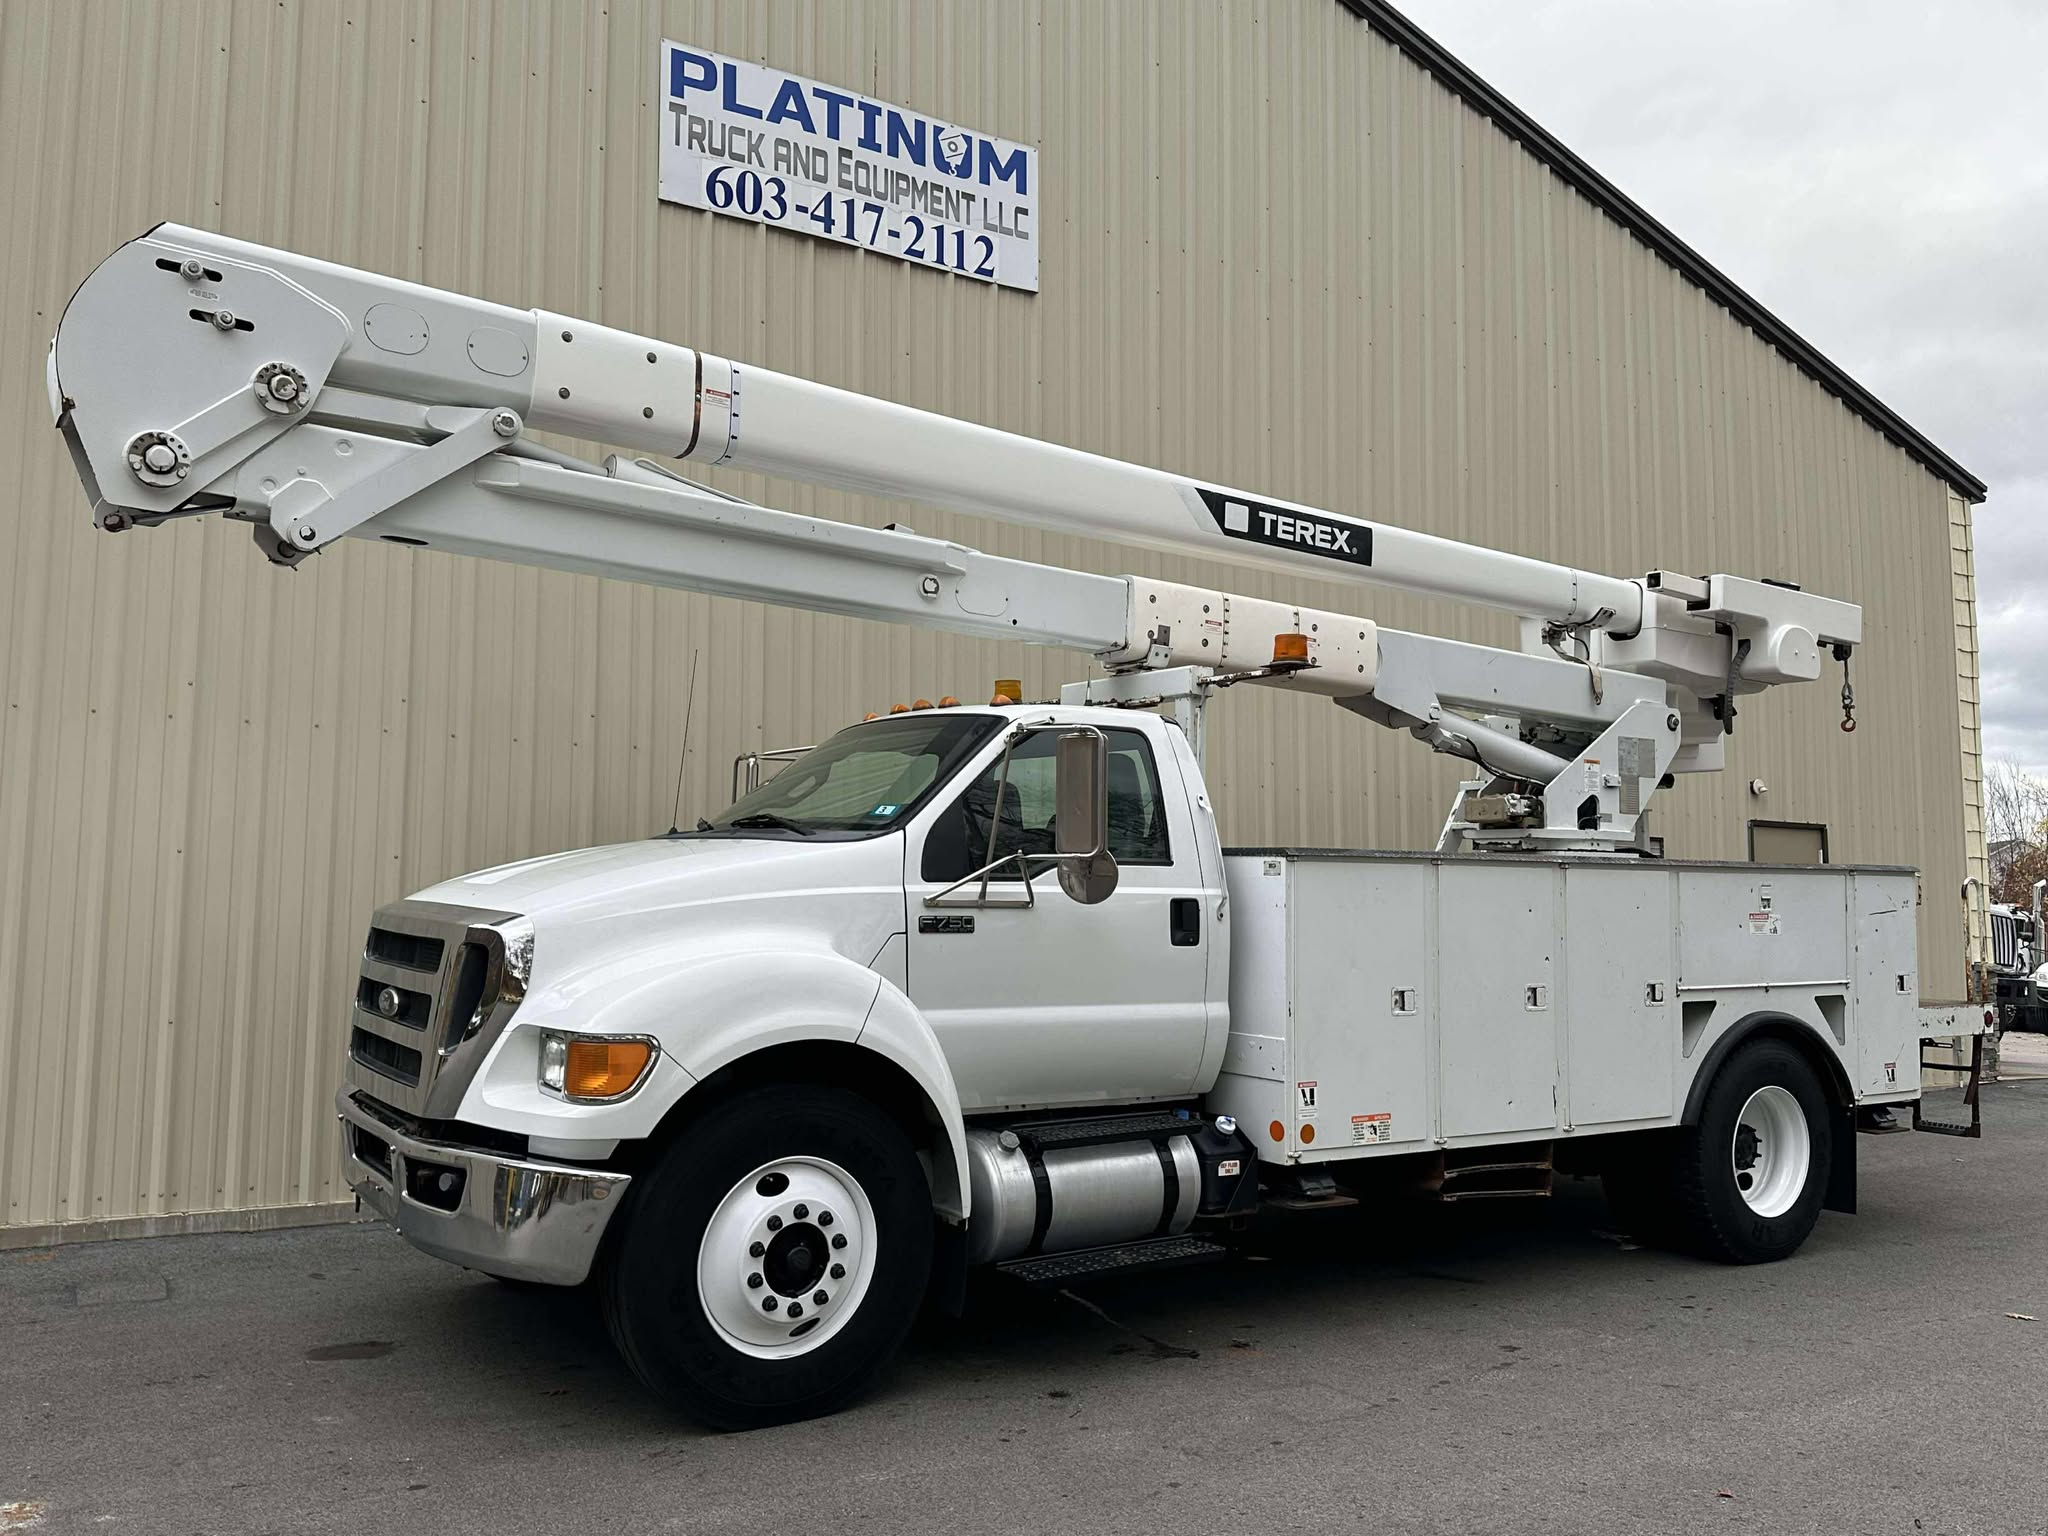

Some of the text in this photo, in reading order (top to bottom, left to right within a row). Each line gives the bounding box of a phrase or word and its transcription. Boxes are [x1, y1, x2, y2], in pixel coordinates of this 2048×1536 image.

[668, 101, 1029, 240] TRUCK AND EQUIPMENT LLC
[670, 47, 1028, 196] PLATINUM
[706, 166, 996, 278] 603-417-2112
[1258, 511, 1351, 553] TEREX
